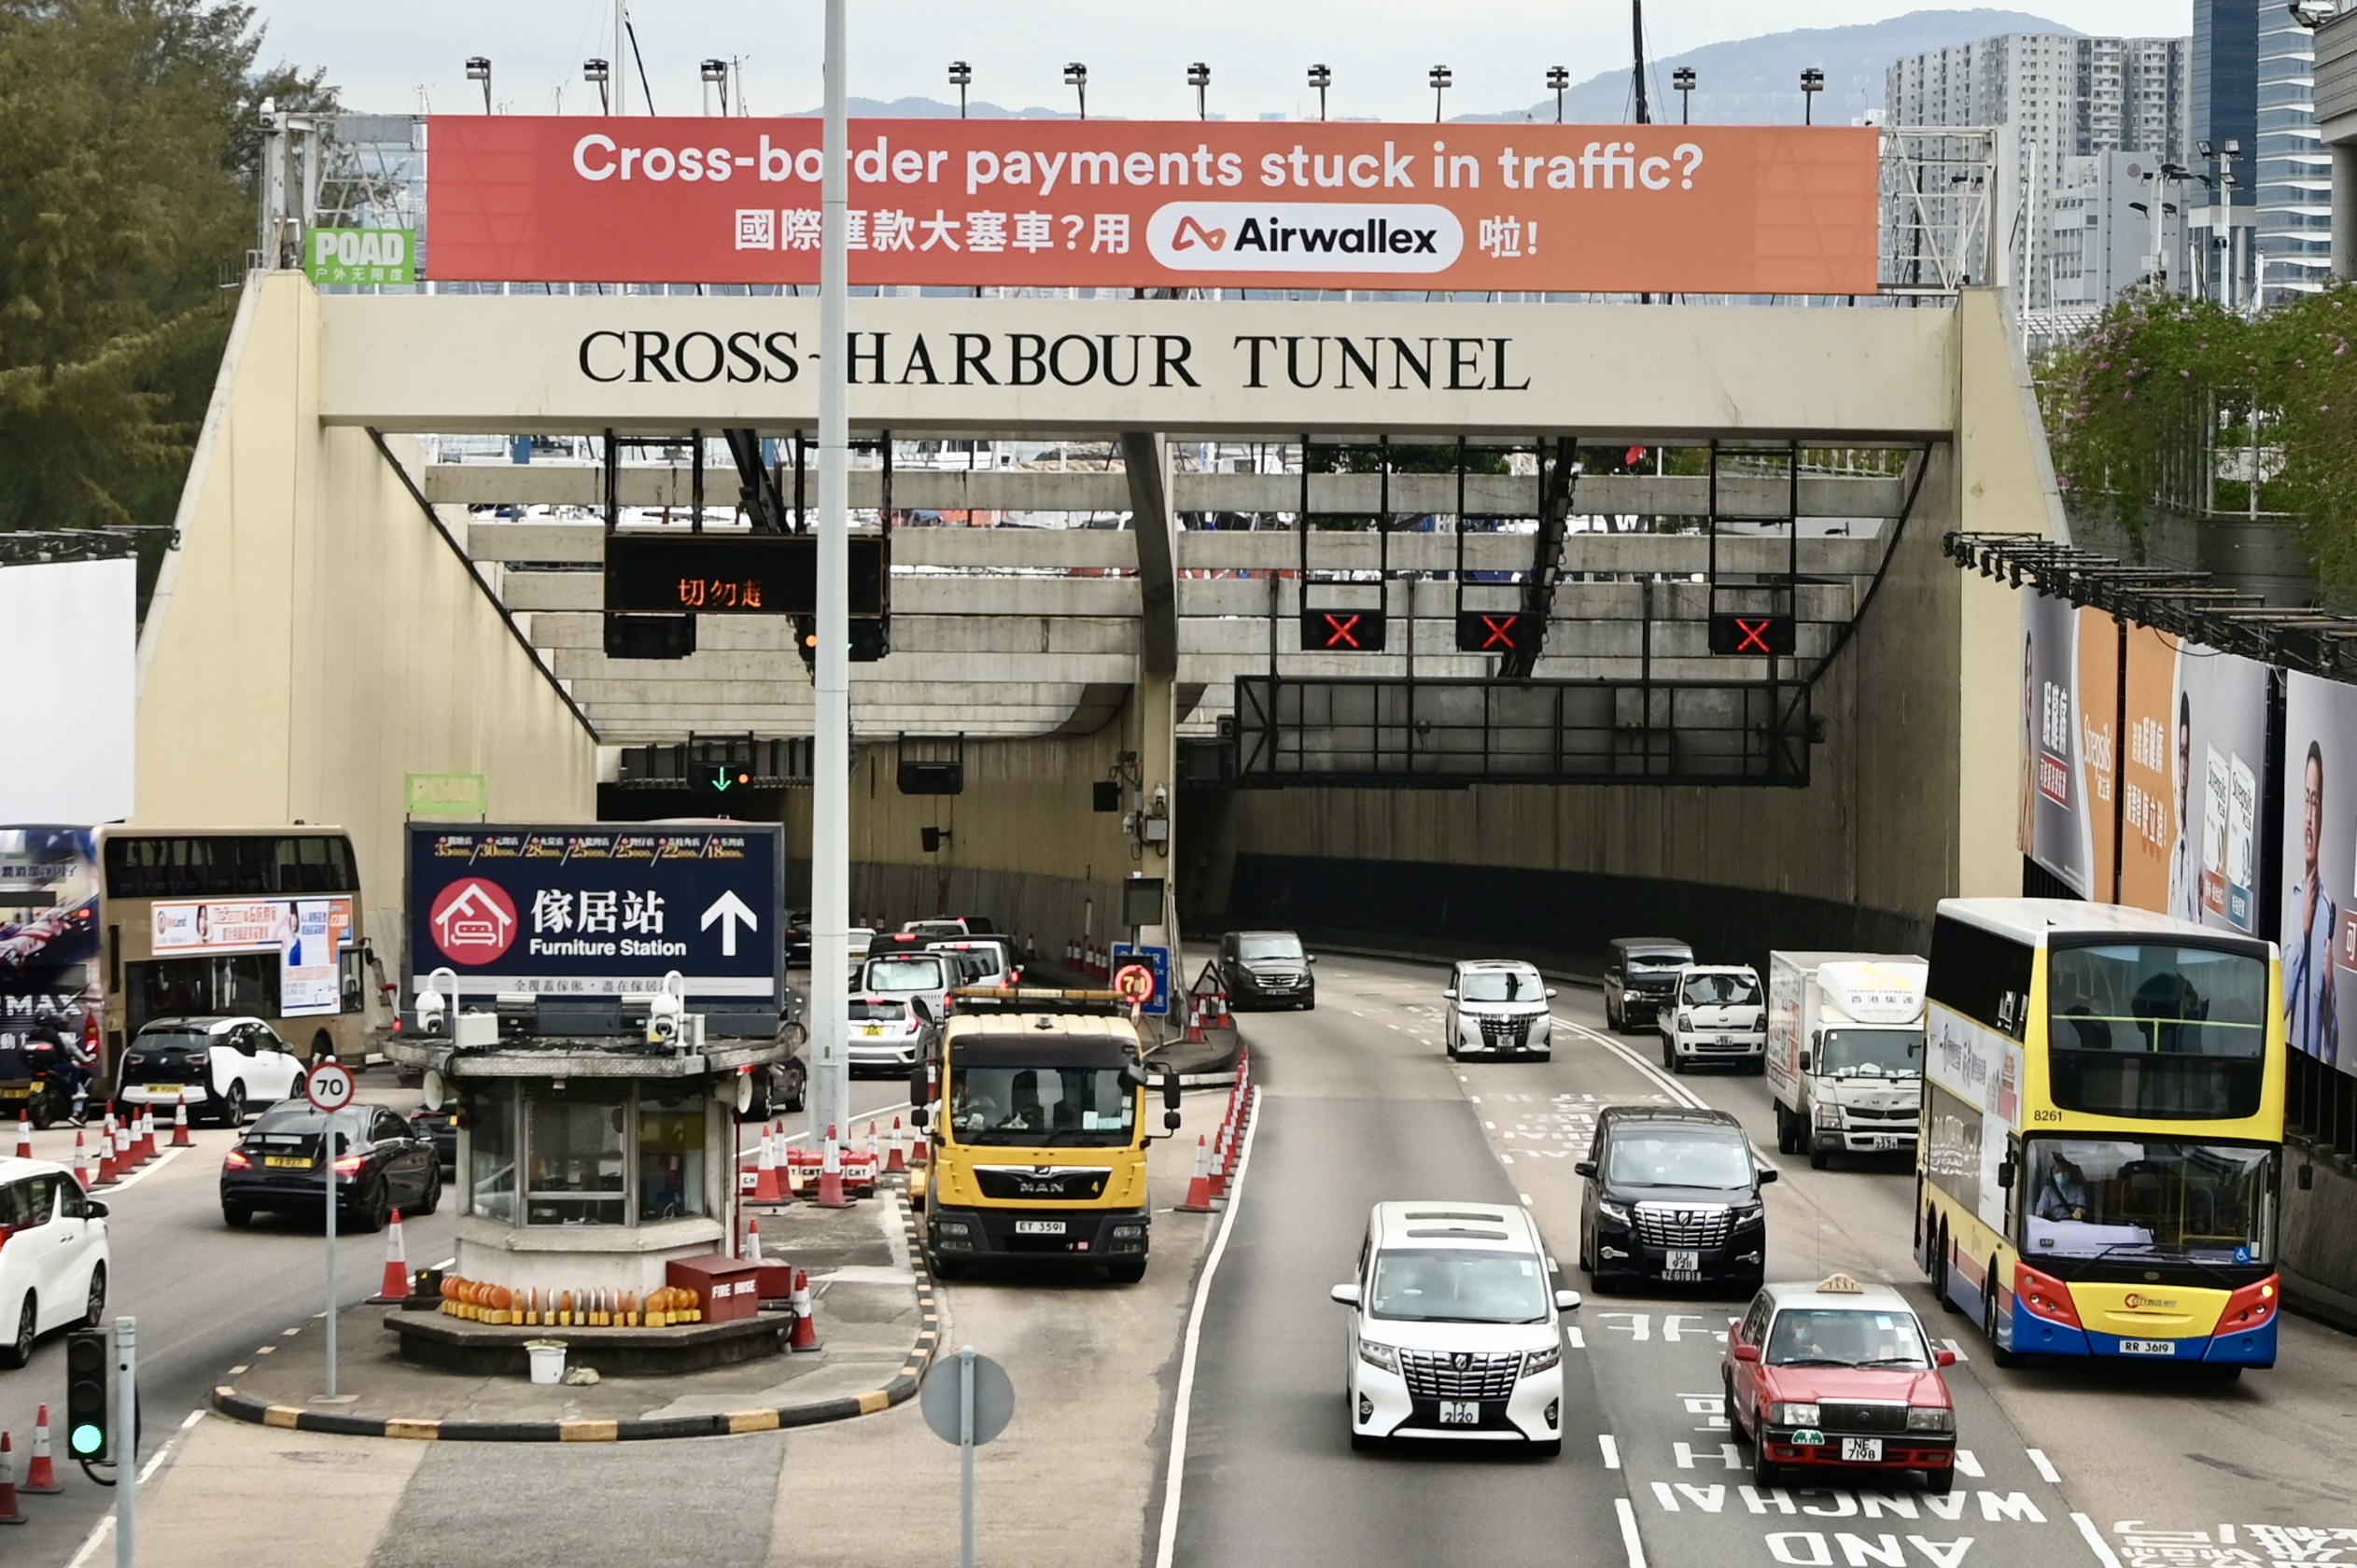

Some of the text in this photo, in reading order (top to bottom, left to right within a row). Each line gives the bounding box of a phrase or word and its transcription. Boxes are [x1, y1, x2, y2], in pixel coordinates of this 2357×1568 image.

[572, 133, 1705, 196] Cross-boder payments stuck in traffic?
[1234, 217, 1438, 254] Airwallex
[316, 231, 404, 266] POAD
[1233, 334, 1531, 391] TUNNEL
[530, 889, 666, 934] 傢居站
[529, 938, 687, 956] Furniture Station
[0, 994, 83, 1015] MAX
[316, 1078, 344, 1096] 70
[2033, 1110, 2062, 1122] 8261
[1019, 1181, 1100, 1193] MAN 4
[1019, 1222, 1062, 1232] ET 3591
[712, 1280, 756, 1299] FIRE HOSE
[2126, 1341, 2169, 1352] RR 3619
[1854, 1438, 1871, 1449] NE
[1848, 1449, 1876, 1460] 7198
[1651, 1481, 2047, 1523] WANCHAI
[1763, 1532, 1975, 1568] AND
